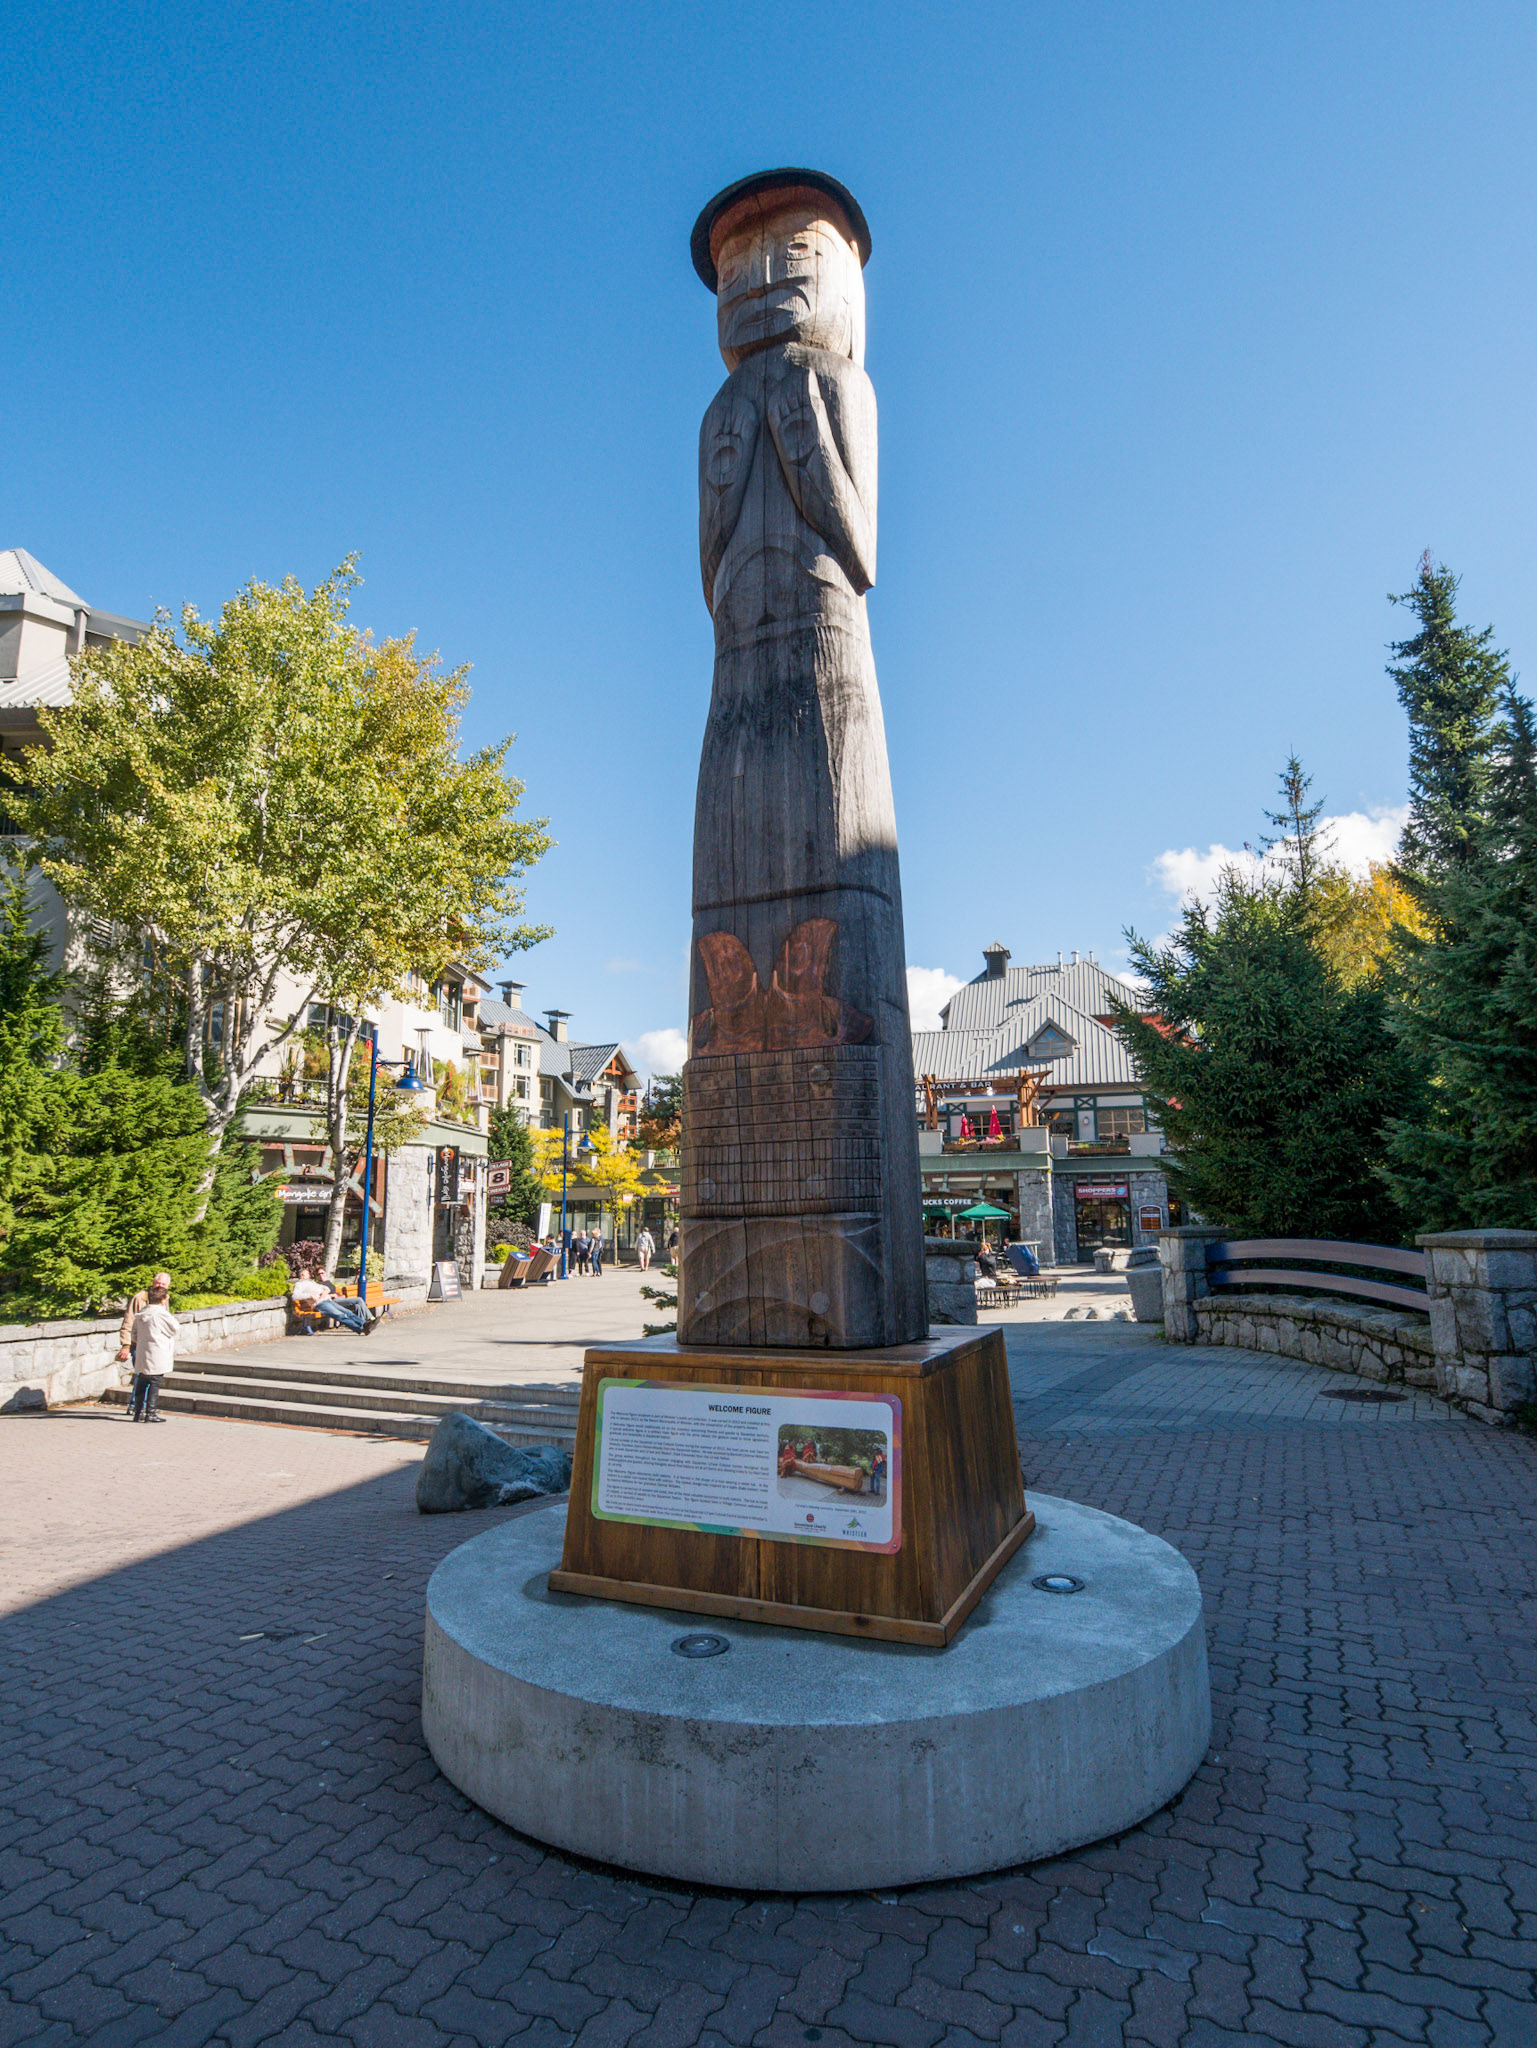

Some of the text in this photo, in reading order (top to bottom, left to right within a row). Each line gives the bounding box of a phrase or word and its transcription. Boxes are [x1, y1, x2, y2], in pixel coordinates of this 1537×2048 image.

[492, 1172, 505, 1183] 8
[708, 1404, 772, 1416] WELCOME FIGURE
